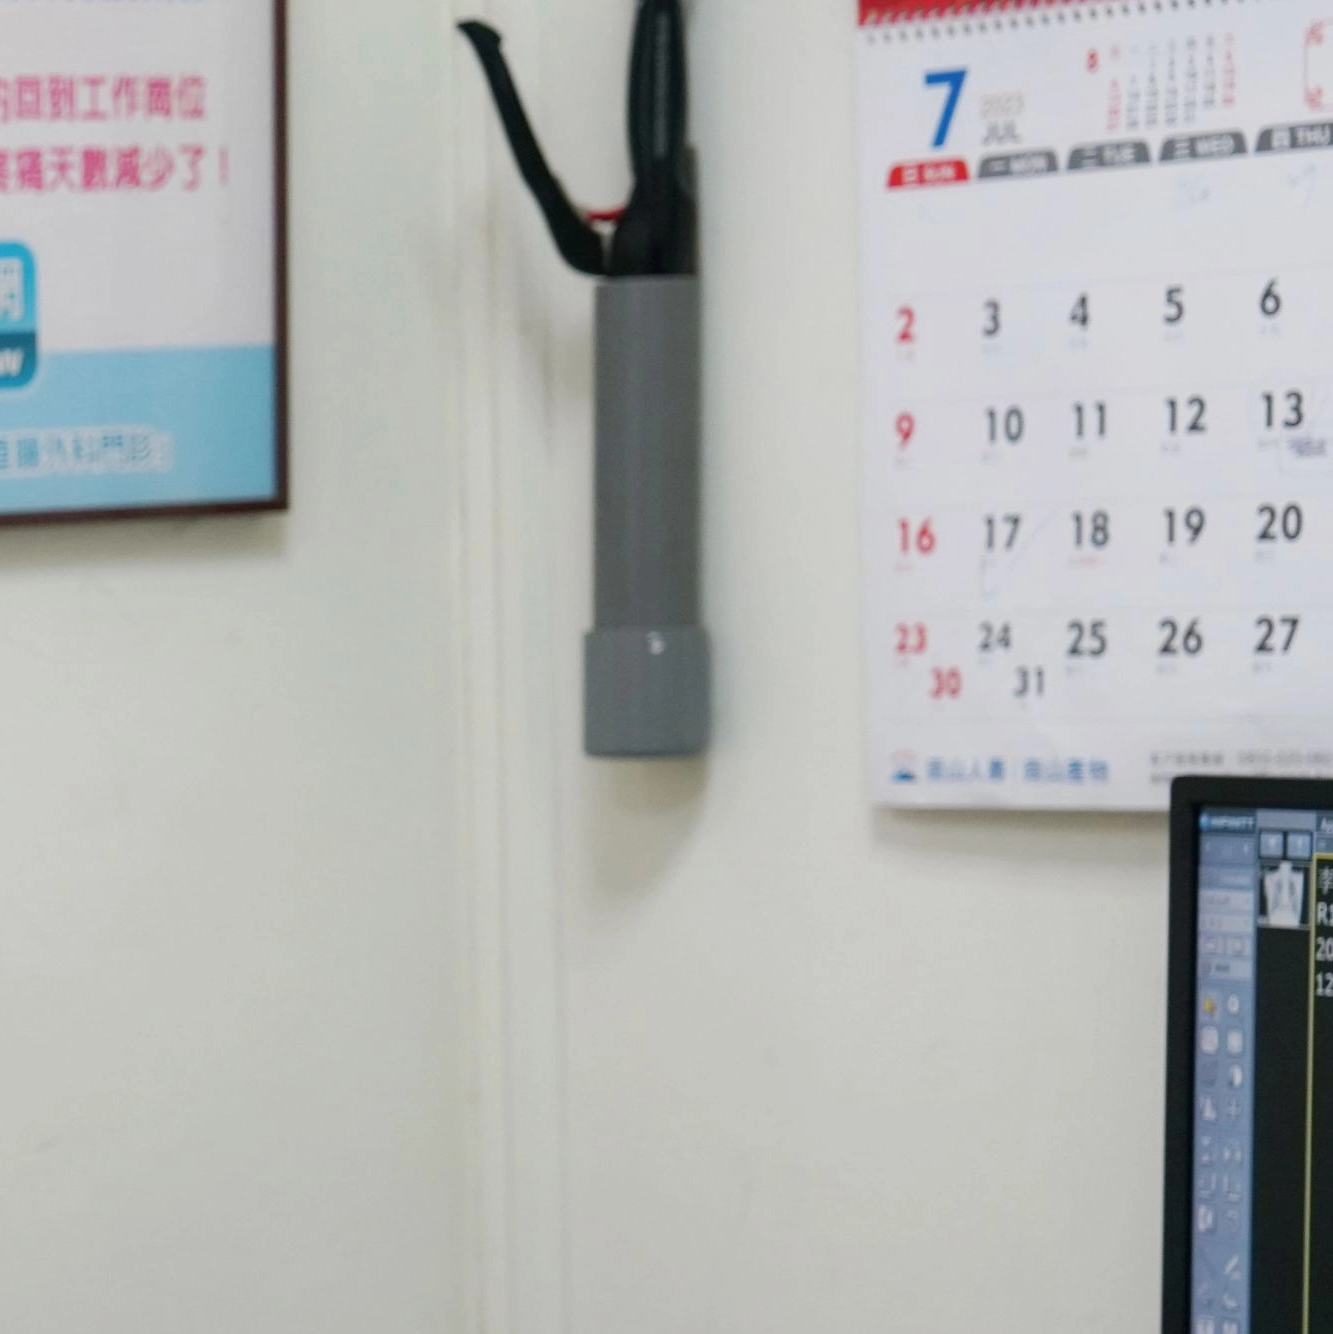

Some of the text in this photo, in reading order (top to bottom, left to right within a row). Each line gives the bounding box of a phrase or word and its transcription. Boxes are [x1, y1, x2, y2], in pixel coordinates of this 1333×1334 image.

[923, 68, 968, 149] 7
[983, 120, 1022, 144] JUL
[1069, 294, 1090, 330] 4
[1163, 286, 1185, 325] 5
[1259, 279, 1282, 318] 6
[897, 306, 915, 344] 2
[982, 299, 1001, 338] 3
[986, 406, 1025, 445] 10
[1073, 402, 1107, 439] 11
[1166, 396, 1206, 434] 12
[1262, 390, 1304, 429] 13
[895, 412, 915, 448] 9
[899, 519, 936, 555] 16
[985, 514, 1022, 551] 17
[1072, 510, 1110, 549] 18
[1164, 507, 1206, 544] 19
[1256, 503, 1303, 543] 20
[895, 623, 927, 655] 23
[978, 622, 1012, 653] 24
[1066, 620, 1108, 658] 25
[1159, 619, 1203, 656] 26
[1254, 616, 1300, 655] 27
[931, 668, 962, 699] 30
[1014, 666, 1045, 698] 31
